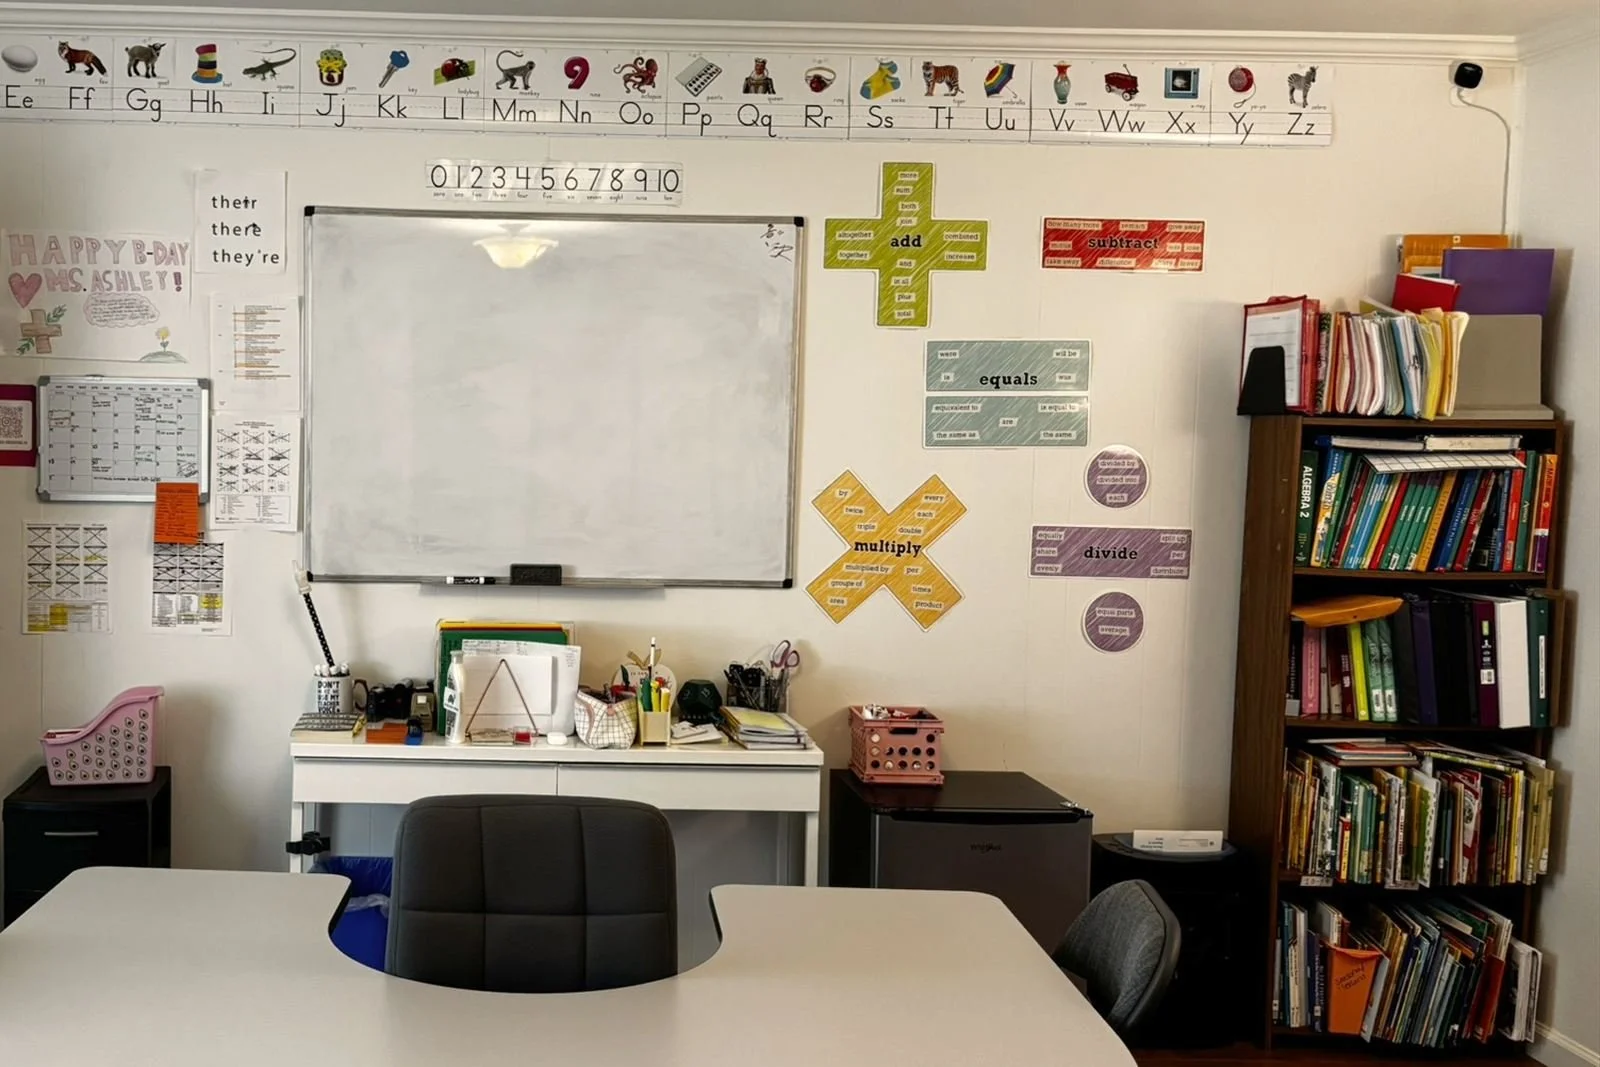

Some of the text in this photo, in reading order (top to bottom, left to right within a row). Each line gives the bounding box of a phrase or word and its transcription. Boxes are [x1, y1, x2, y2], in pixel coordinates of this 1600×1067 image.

[6, 85, 1315, 145] Ee Ff Gg Hh Ii Jj Kk Ll Mm Nn Oo Pp Qq Rr Ss Tt Uu Vv Ww Xx Yy Zz
[431, 165, 680, 192] 0 1 2 3 4 5 6 7 8 9 10
[211, 222, 261, 236] there
[8, 234, 189, 266] HAPPY B-DAY
[890, 235, 922, 248] add
[1088, 236, 1159, 249] subtract
[213, 249, 280, 267] they're
[44, 267, 87, 292] MS.
[979, 373, 1038, 389] equals
[1300, 465, 1313, 509] ALGEBRA
[854, 540, 922, 557] multiply
[1084, 546, 1138, 560] divide
